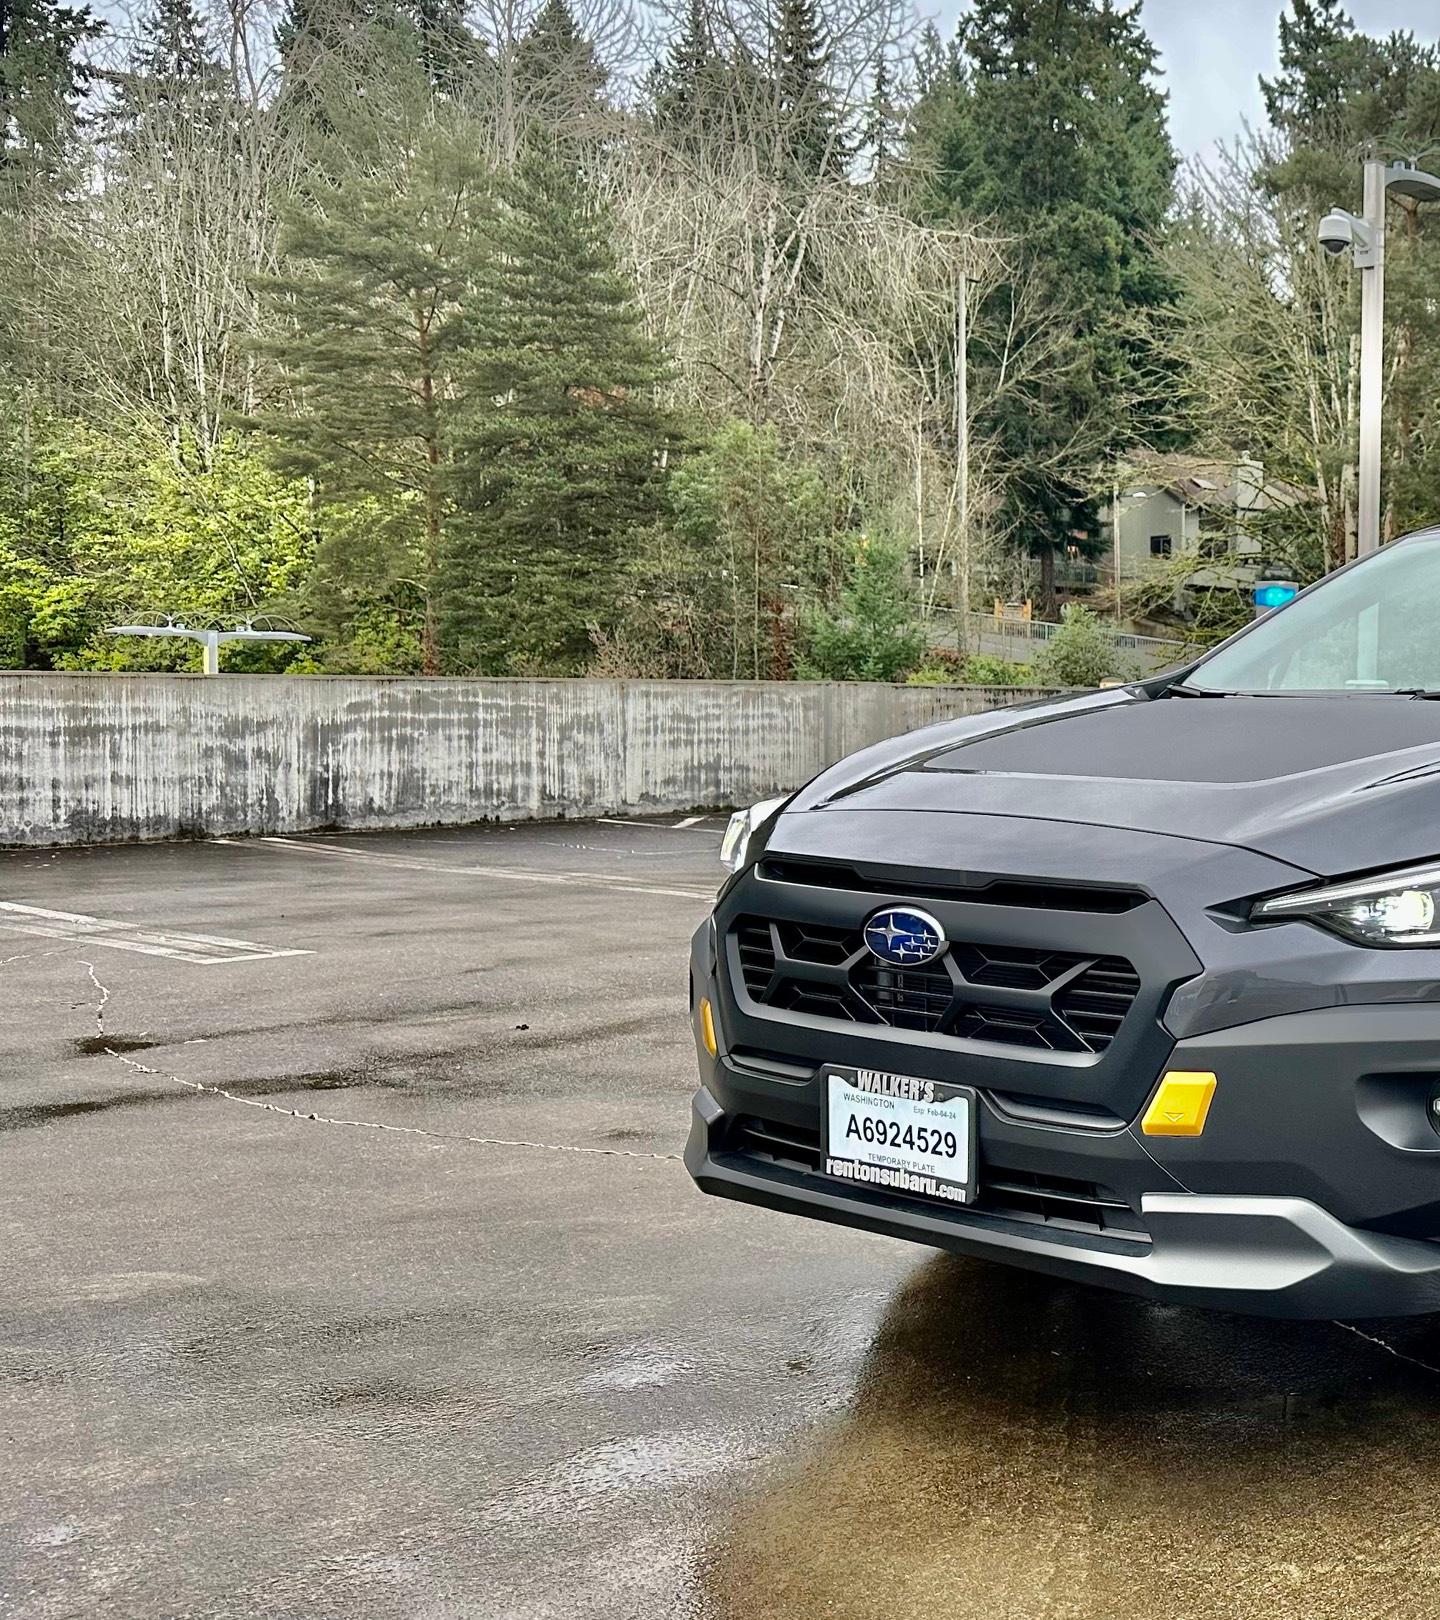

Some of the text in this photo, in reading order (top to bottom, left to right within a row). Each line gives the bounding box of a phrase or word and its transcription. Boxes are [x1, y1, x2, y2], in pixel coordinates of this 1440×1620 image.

[843, 1092, 895, 1110] WASHINGTON
[857, 1070, 935, 1103] WALKER'S
[845, 1113, 957, 1158] A6924529
[868, 1152, 936, 1174] TEMPORARY PLATE
[825, 1158, 966, 1203] rentonsubaru.com
